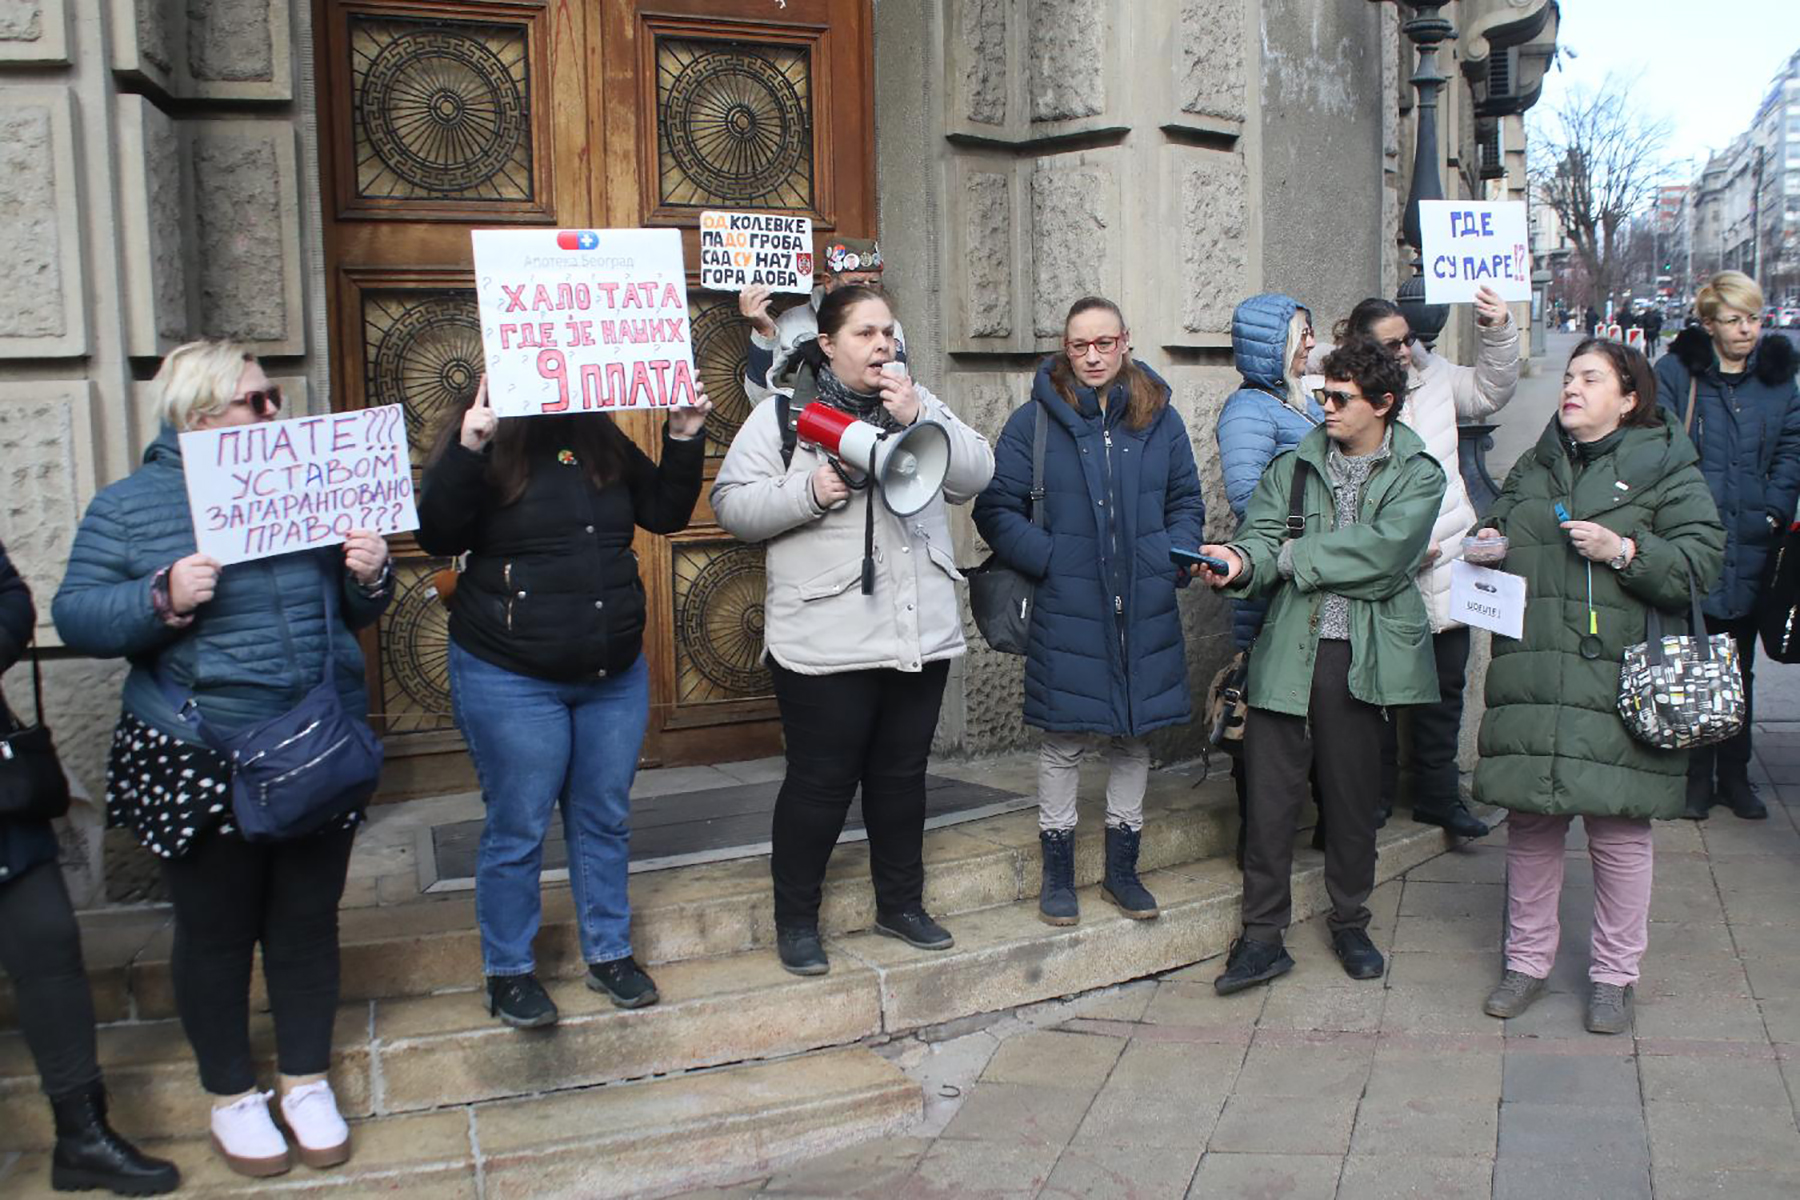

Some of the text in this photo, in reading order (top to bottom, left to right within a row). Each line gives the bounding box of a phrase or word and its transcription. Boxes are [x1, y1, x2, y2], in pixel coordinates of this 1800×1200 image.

[703, 215, 806, 234] ОД КОЛЕВКЕ
[1450, 211, 1494, 238] ГДЕ
[702, 231, 803, 251] ПА ДО ГРОБА
[702, 250, 732, 267] САД
[734, 251, 751, 267] СУ
[1433, 255, 1456, 278] СУ
[702, 269, 798, 287] ГОРА ДОБА
[501, 281, 682, 312] ХАЛО ТАТА
[500, 322, 557, 349] ГДЕ
[601, 317, 685, 345] НАШИХ
[536, 349, 698, 413] 9 ПЛАТА
[232, 453, 398, 500] УСТАВОМ
[206, 476, 410, 531] ЗАГАРАНТОВАНО
